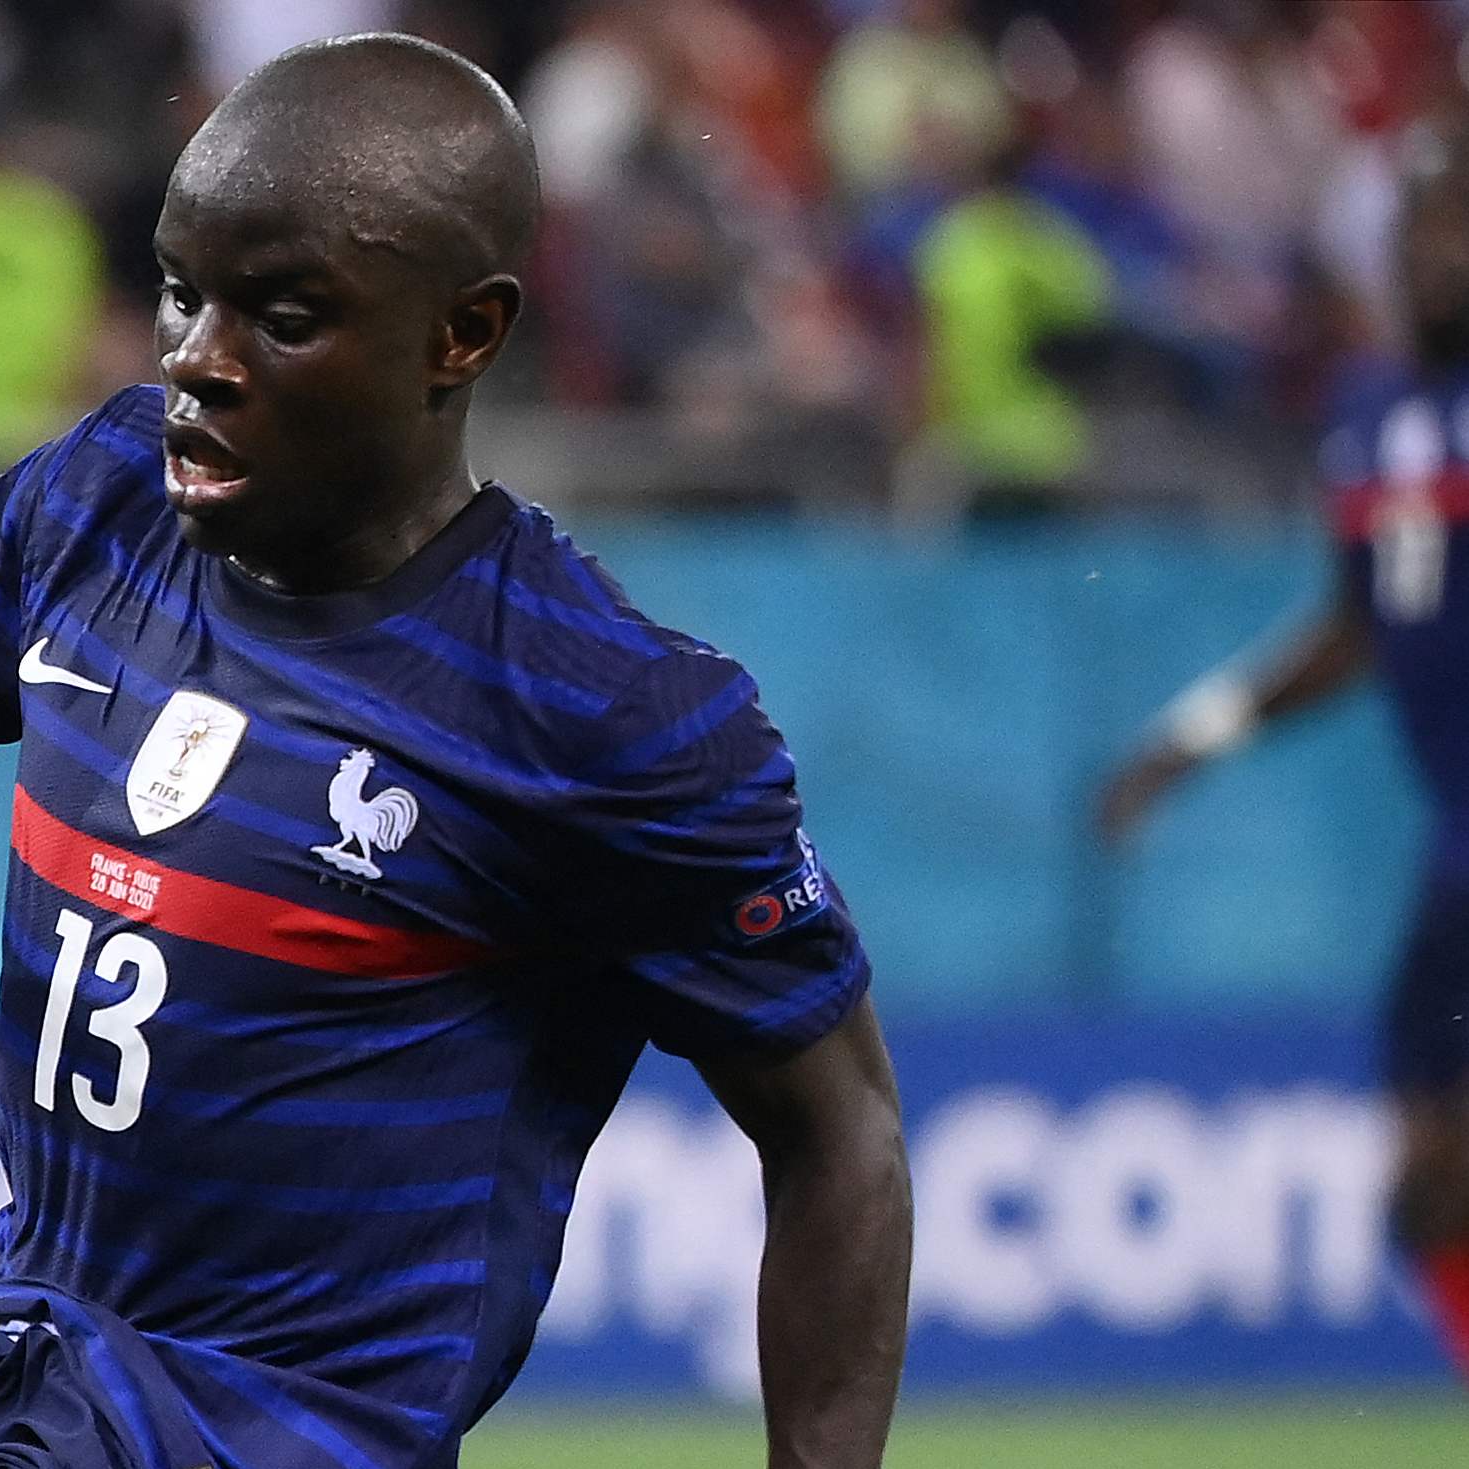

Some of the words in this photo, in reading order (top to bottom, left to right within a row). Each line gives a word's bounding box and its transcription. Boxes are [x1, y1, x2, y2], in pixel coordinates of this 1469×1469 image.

[149, 781, 180, 803] FIFA
[127, 886, 154, 911] 2021
[33, 909, 168, 1133] 13
